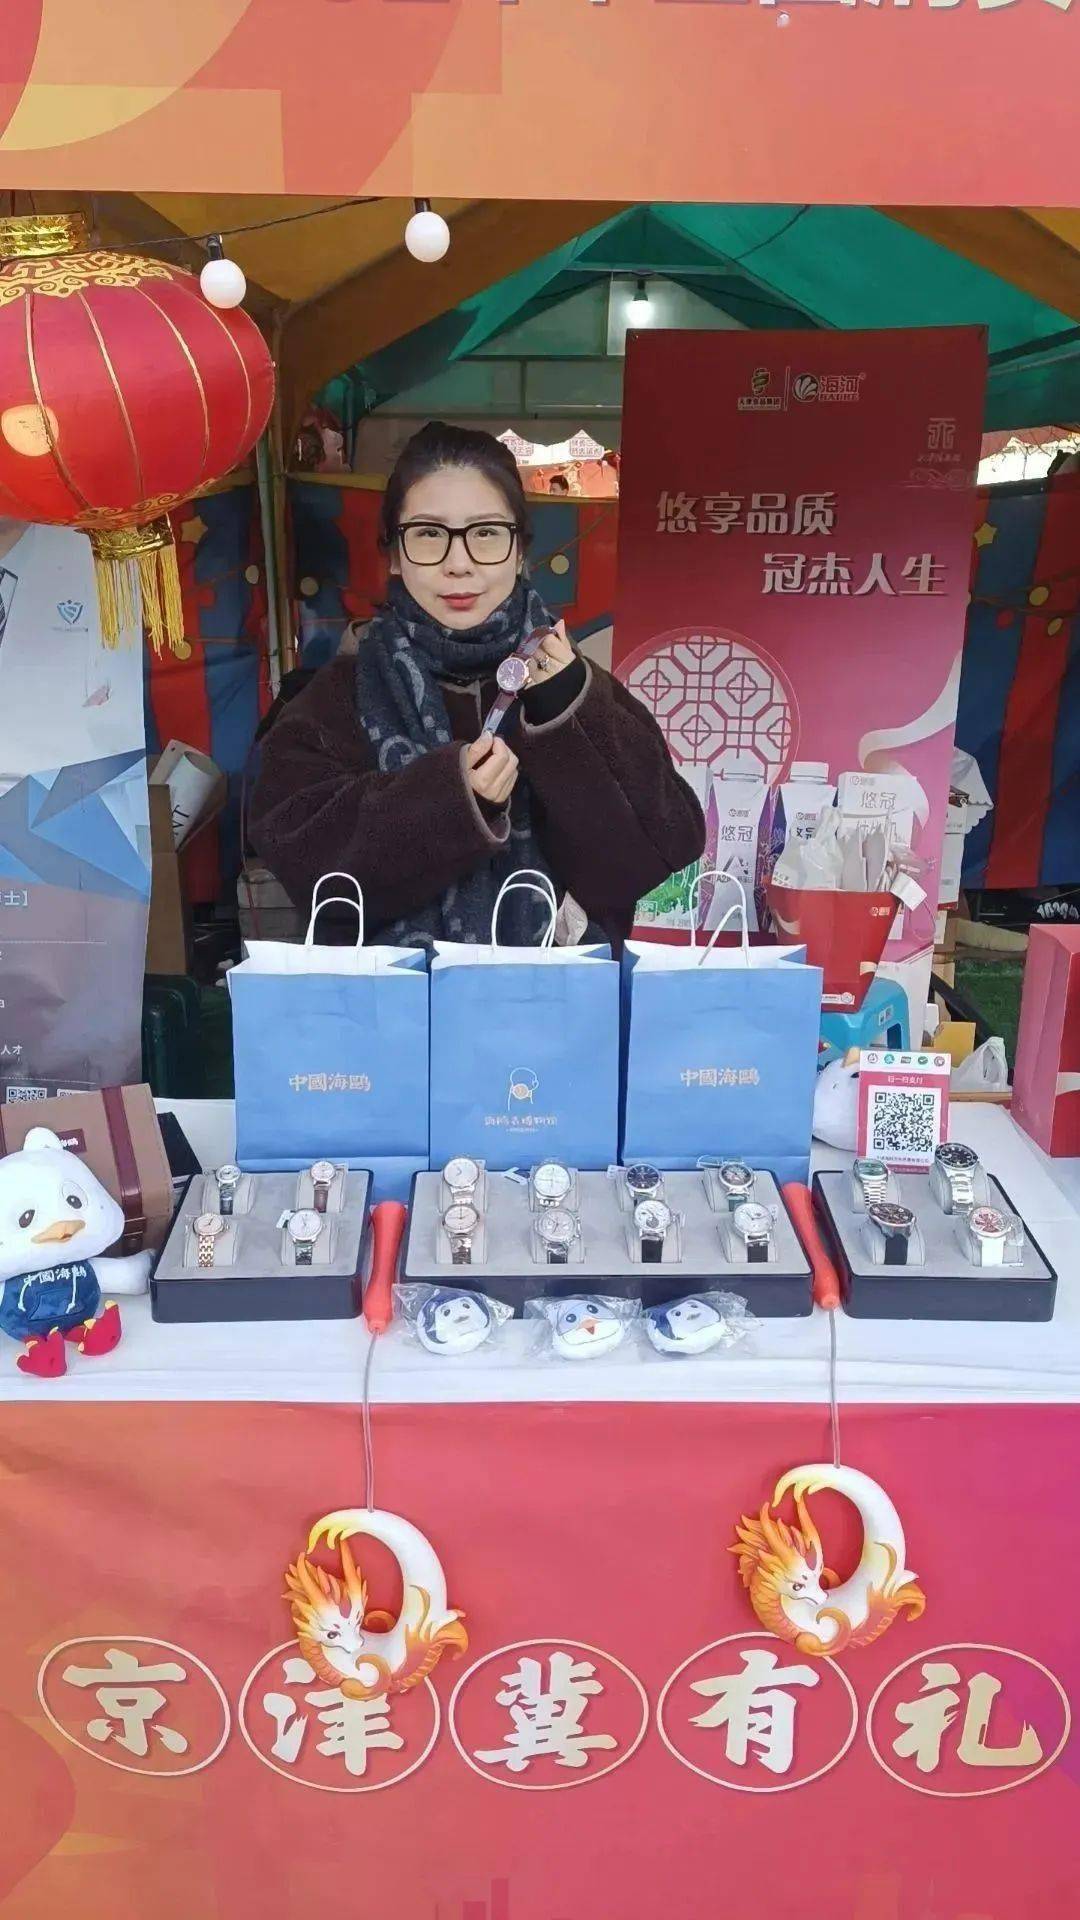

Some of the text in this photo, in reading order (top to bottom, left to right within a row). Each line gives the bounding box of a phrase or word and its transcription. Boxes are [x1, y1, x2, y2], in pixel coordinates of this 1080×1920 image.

[820, 375, 860, 394] 海河
[656, 491, 838, 535] 悠享品质
[762, 552, 946, 596] 冠杰人生
[860, 791, 896, 809] 悠冠
[720, 824, 753, 842] 悠冠
